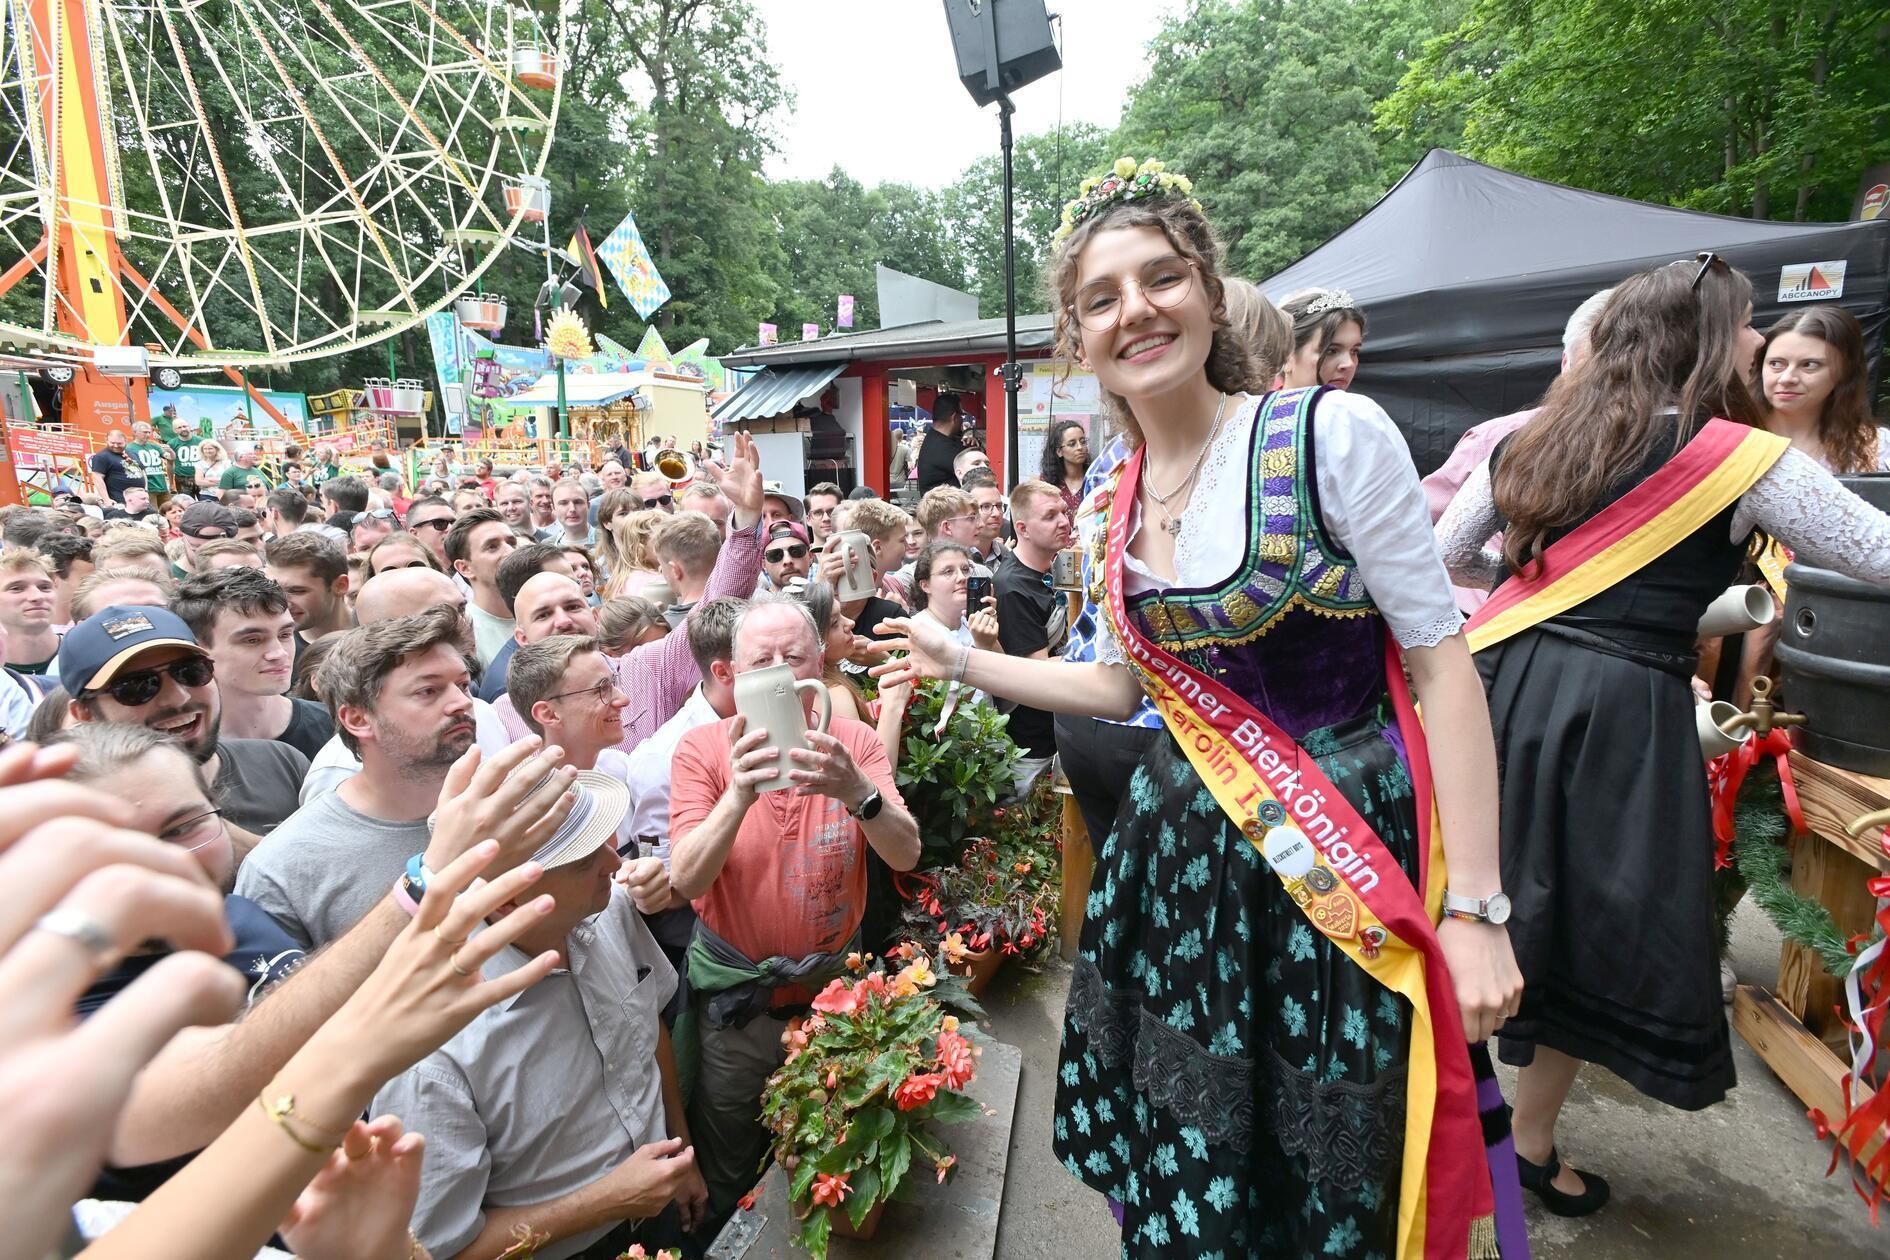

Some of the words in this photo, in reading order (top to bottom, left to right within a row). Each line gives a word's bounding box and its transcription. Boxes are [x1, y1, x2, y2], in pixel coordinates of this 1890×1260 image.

[1781, 289, 1838, 299] ABCCANOPY
[94, 401, 134, 409] Ausgan
[1156, 687, 1238, 786] Karolin
[1231, 719, 1380, 894] Bierkönigin
